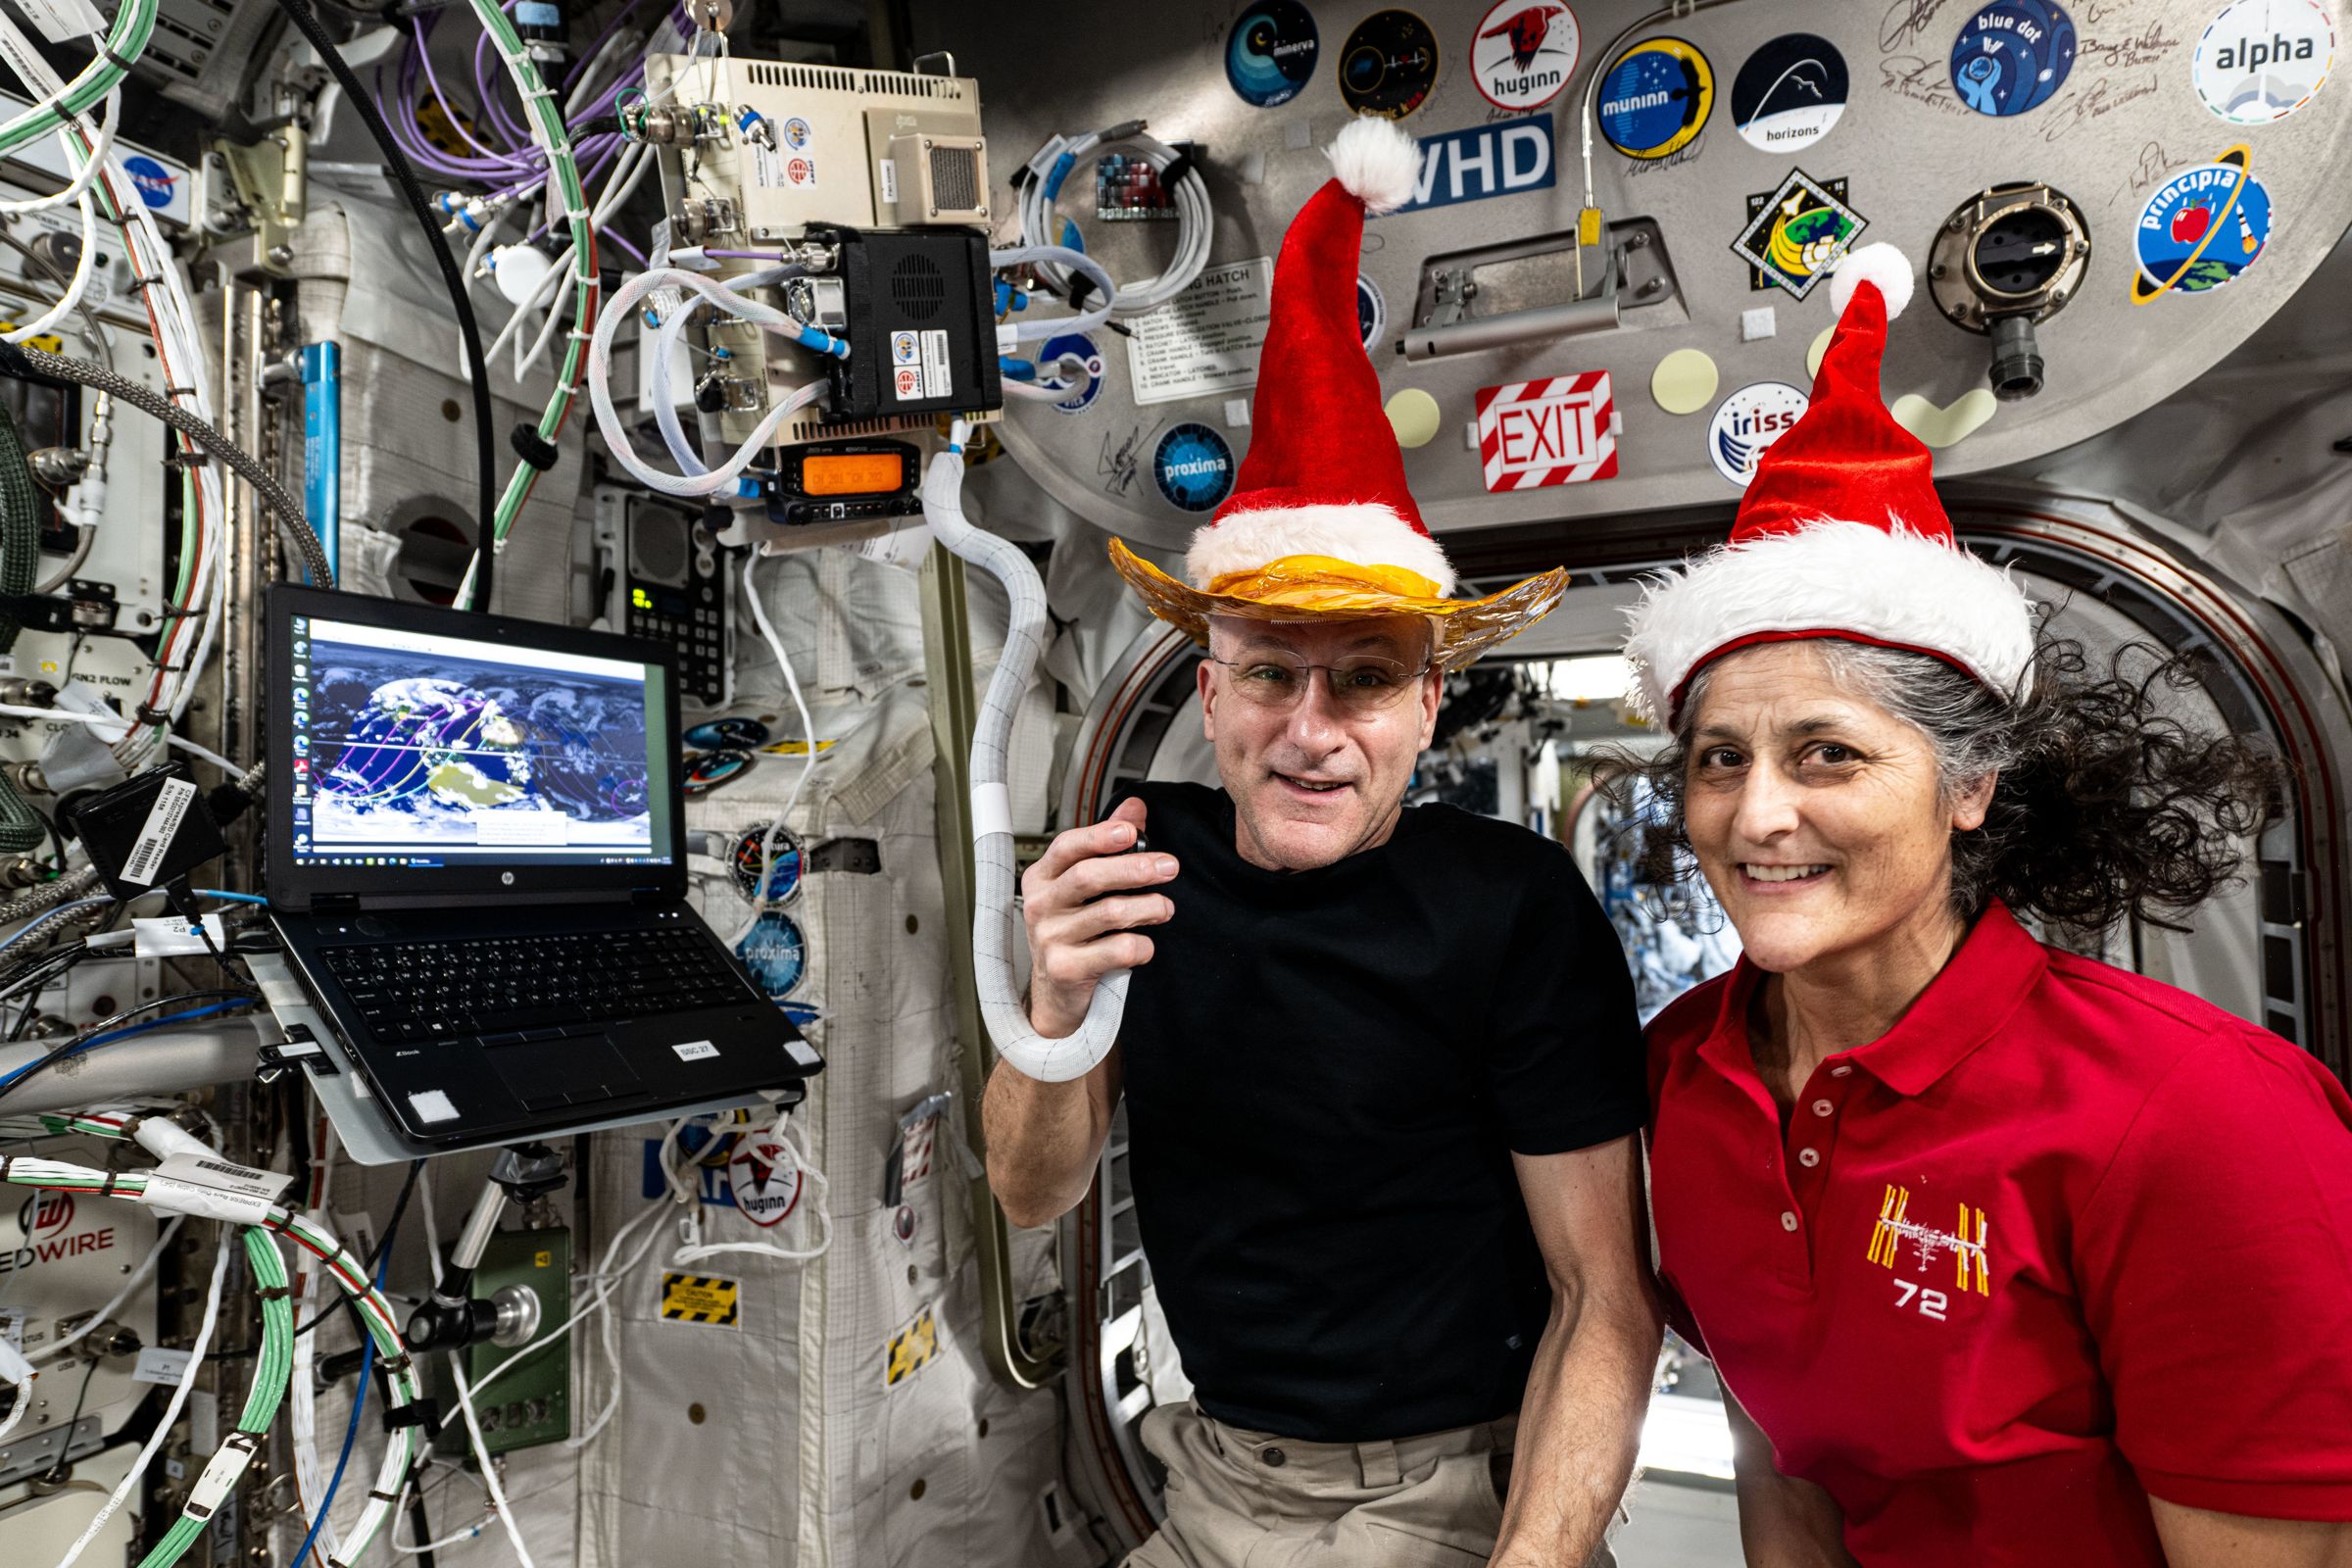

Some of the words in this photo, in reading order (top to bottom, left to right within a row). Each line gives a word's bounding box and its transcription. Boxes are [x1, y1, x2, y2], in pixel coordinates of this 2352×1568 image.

[1979, 13, 2014, 30] blue
[2017, 20, 2041, 44] dot
[1274, 39, 1314, 57] minerva
[2216, 33, 2314, 74] alpha
[1494, 70, 1560, 96] huginn
[1602, 90, 1669, 117] muninn
[1766, 124, 1820, 141] horizons
[1414, 124, 1550, 204] VHD
[1751, 196, 1764, 207] 122
[2140, 170, 2237, 231] principia
[1205, 269, 1250, 287] HATCH
[1499, 399, 1591, 466] EXIT
[1733, 409, 1794, 437] iriss
[1164, 454, 1227, 482] proxima
[99, 675, 131, 686] FLOW
[158, 831, 172, 848] Card
[147, 848, 164, 870] Reader
[745, 944, 800, 962] proxima
[743, 1196, 786, 1214] huginn
[0, 1227, 115, 1273] EDWIRE
[1893, 1278, 1948, 1322] 72
